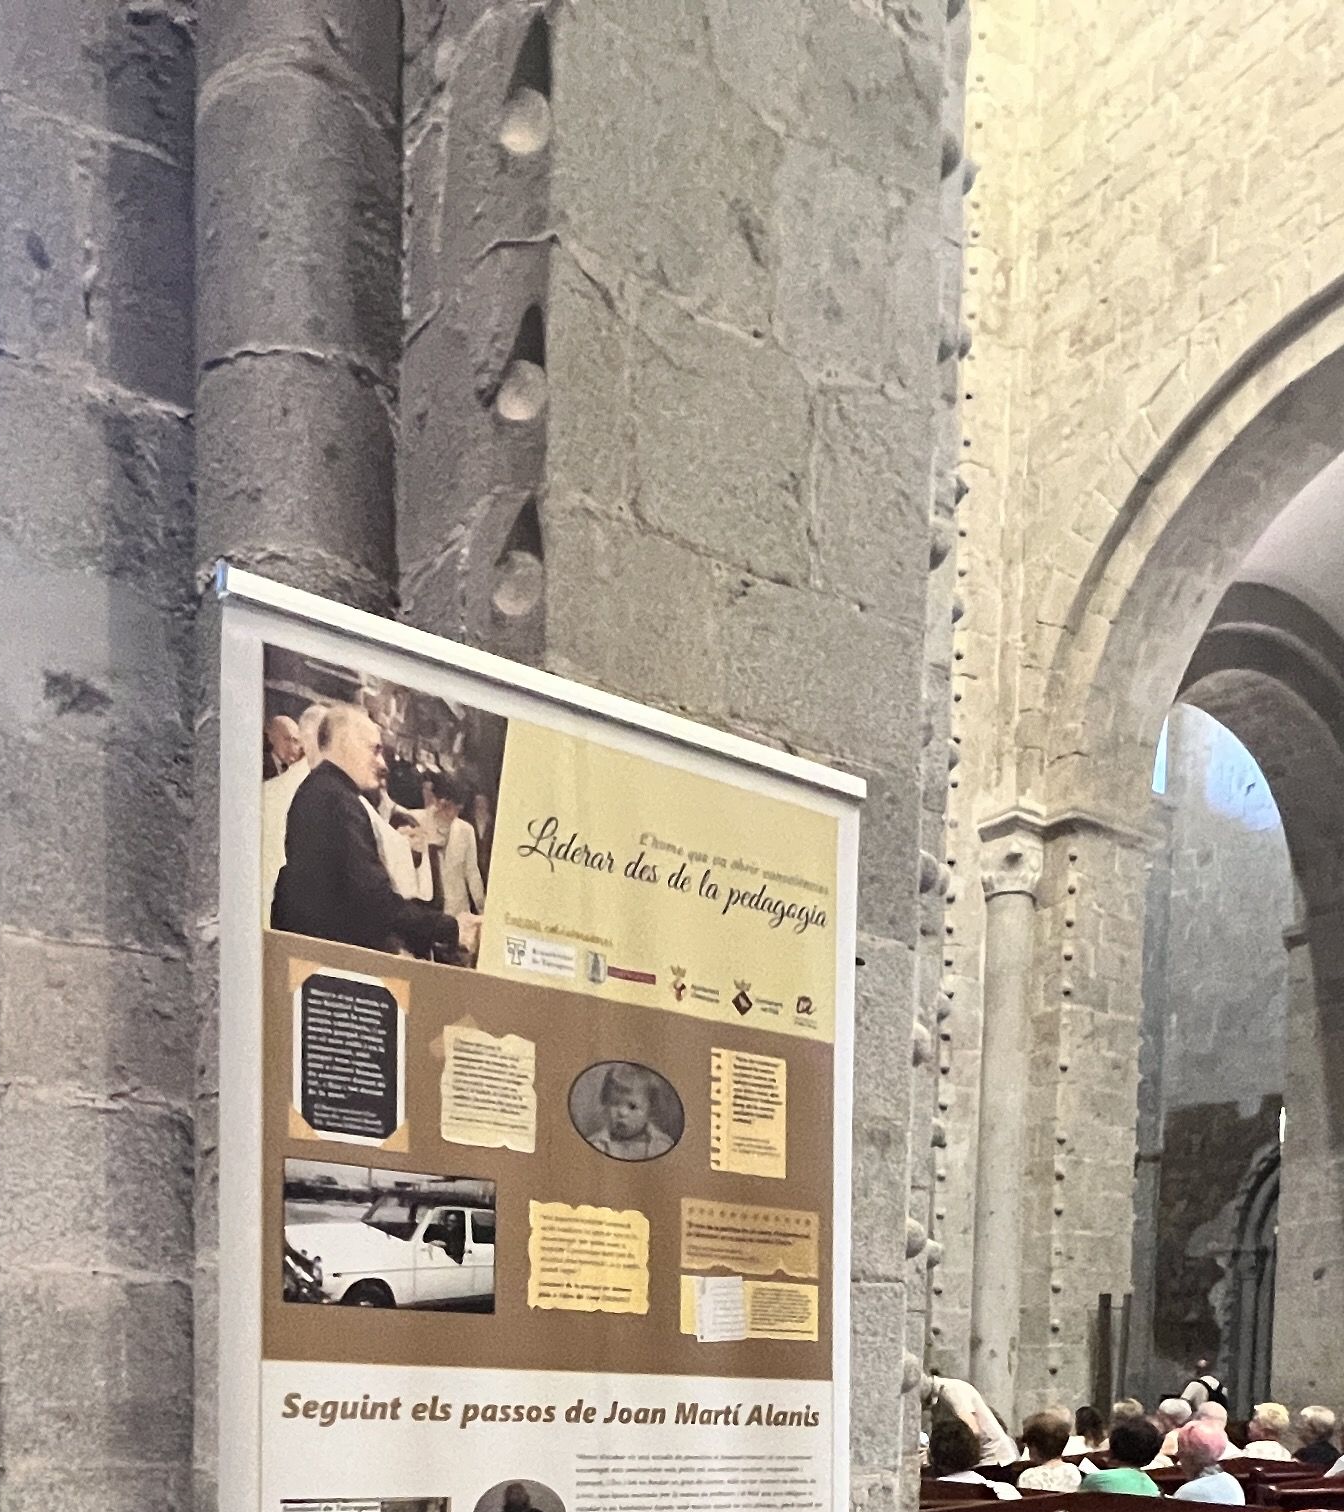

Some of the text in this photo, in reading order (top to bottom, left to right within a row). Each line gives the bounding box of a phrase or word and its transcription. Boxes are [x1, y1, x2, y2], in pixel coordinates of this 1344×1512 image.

[517, 816, 828, 935] Liderar des de la pedagogia
[281, 1392, 820, 1430] Seguint els passos de Joan Martí Alanis
